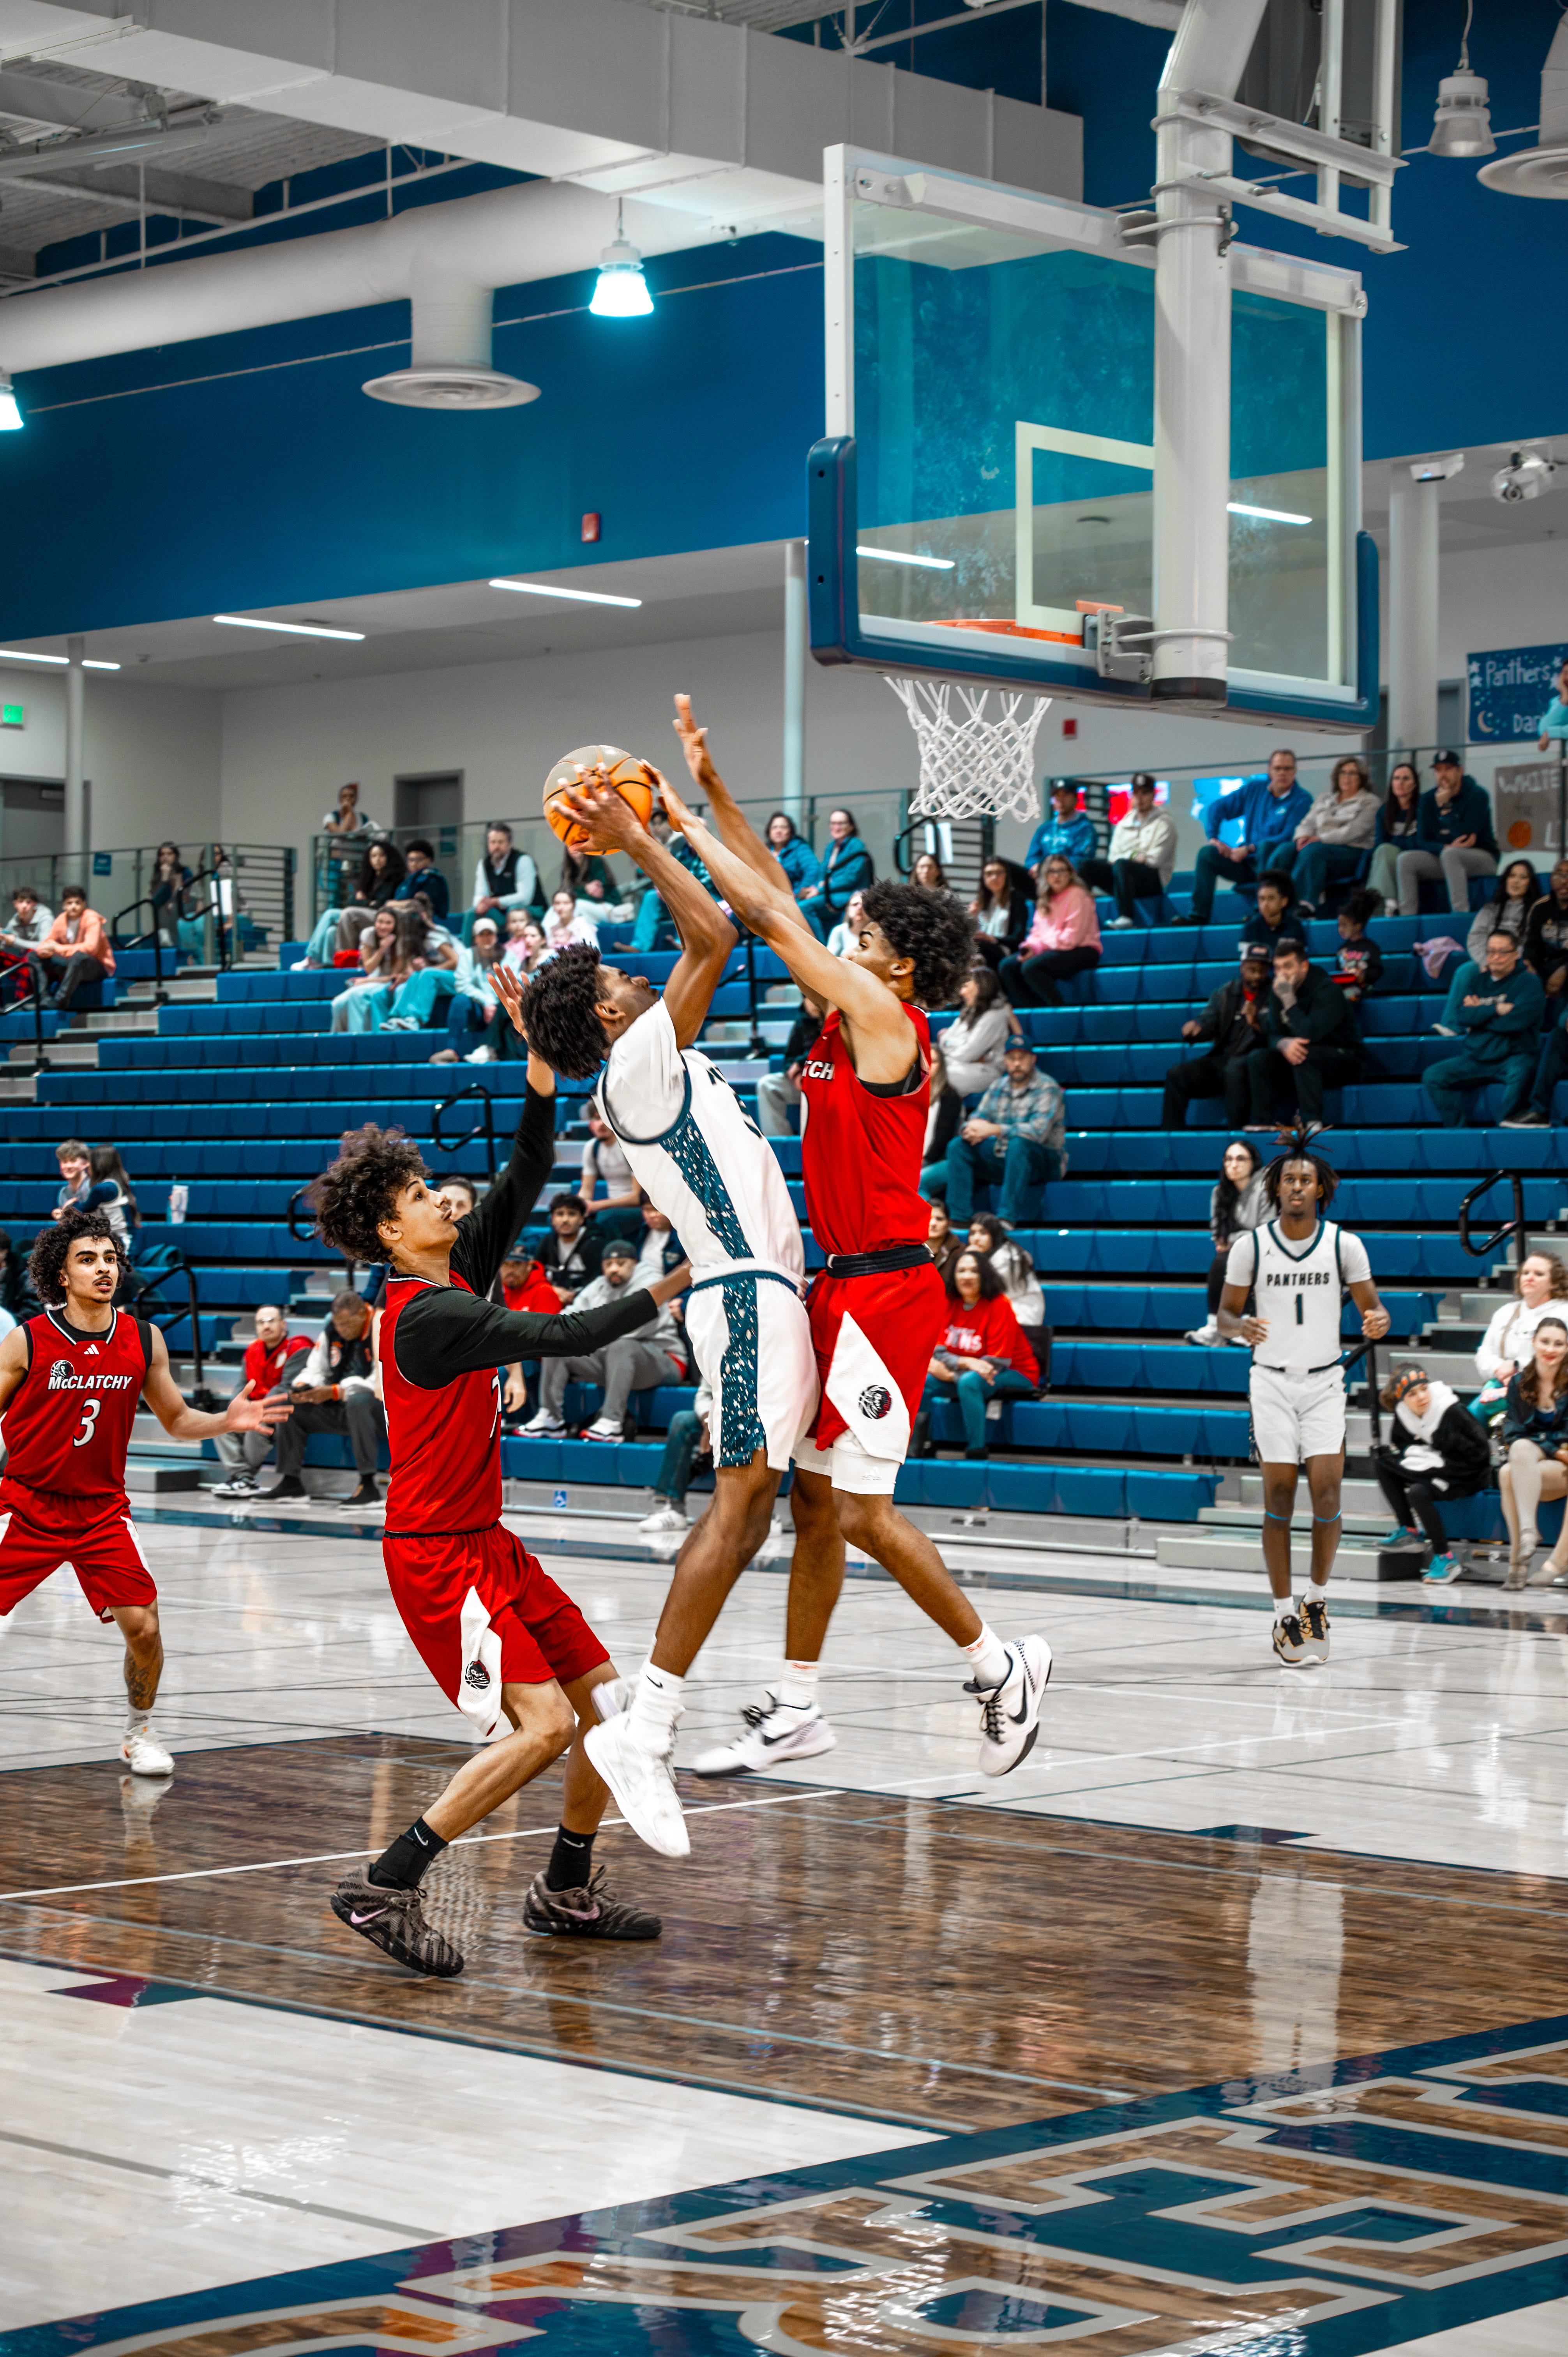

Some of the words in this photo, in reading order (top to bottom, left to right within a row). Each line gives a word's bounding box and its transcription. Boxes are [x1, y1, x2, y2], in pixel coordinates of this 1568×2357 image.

[1485, 657, 1550, 688] Panthers
[1267, 1272, 1330, 1286] PANTHERS
[1294, 1293, 1303, 1325] 1
[47, 1375, 134, 1390] McCLATCHY
[73, 1398, 101, 1447] 3
